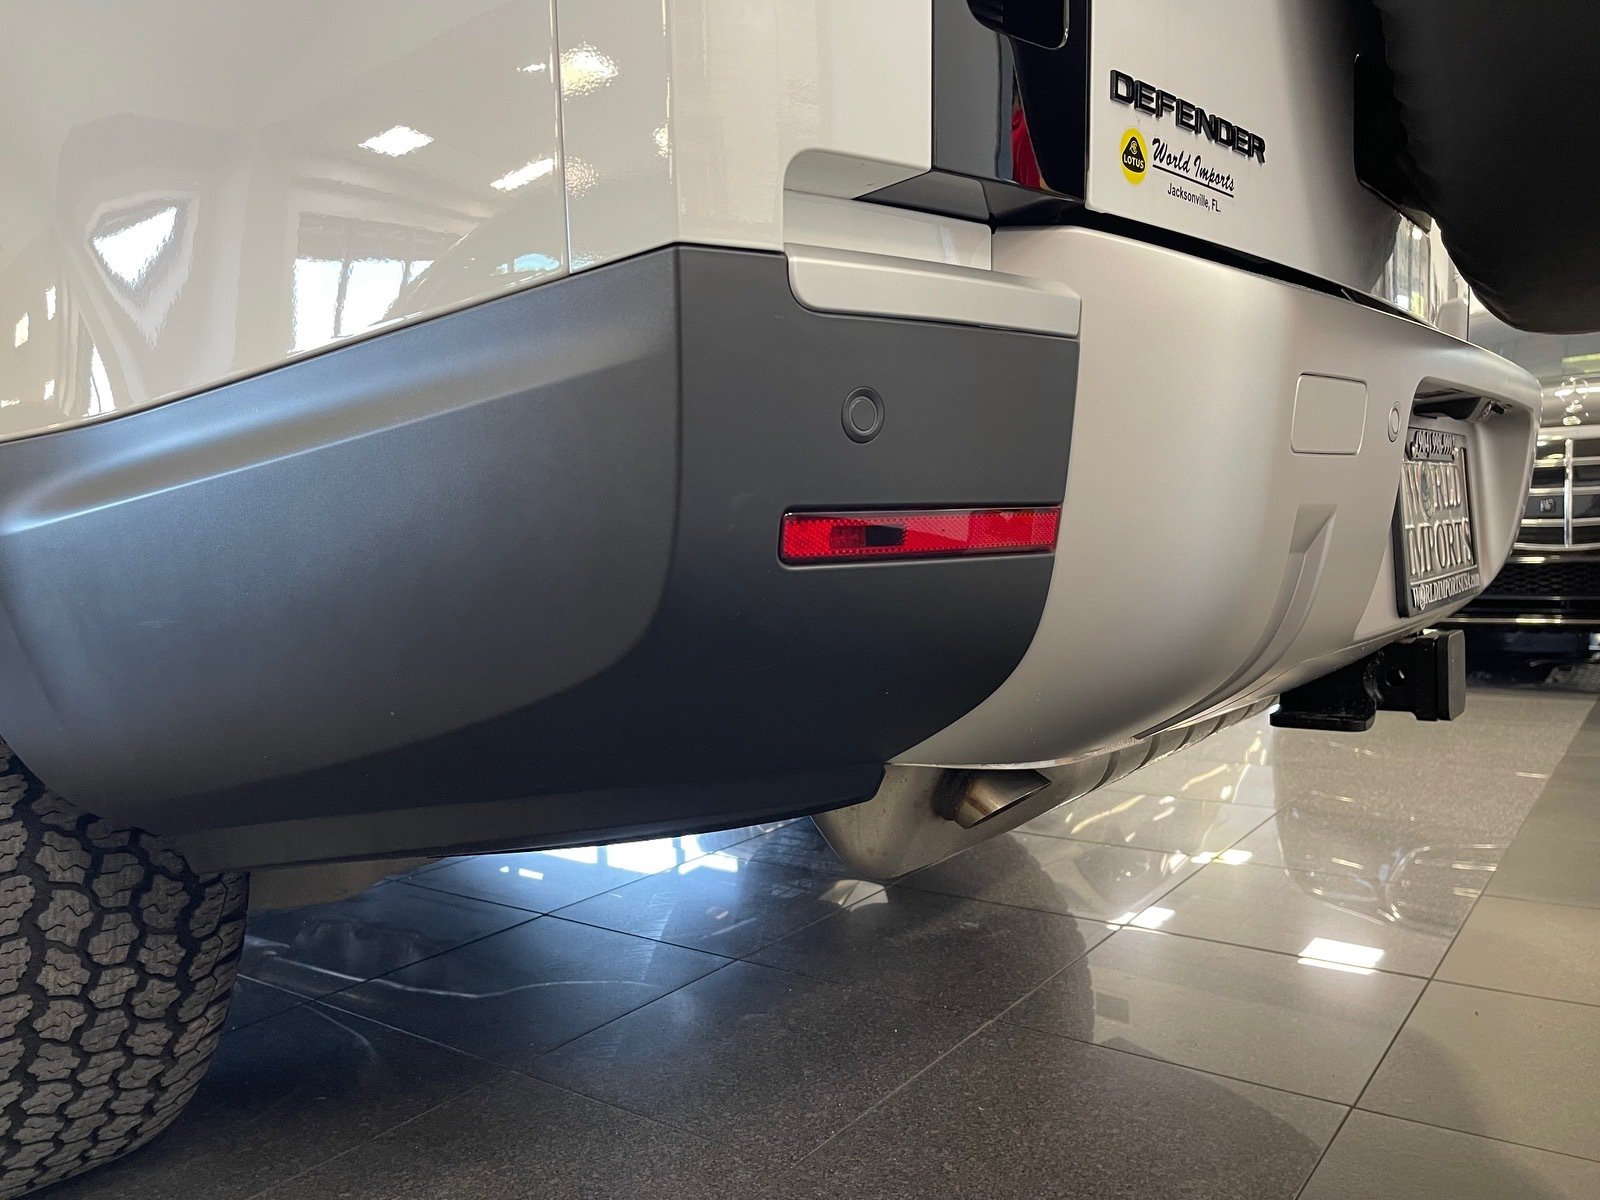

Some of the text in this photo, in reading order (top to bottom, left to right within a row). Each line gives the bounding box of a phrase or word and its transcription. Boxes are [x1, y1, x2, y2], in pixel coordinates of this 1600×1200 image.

[1110, 69, 1266, 163] DEFENDER
[1124, 154, 1145, 169] LOTUS
[1152, 138, 1234, 191] World Imports
[1168, 182, 1210, 211] Jacksonville,
[1401, 461, 1460, 520] WORLD
